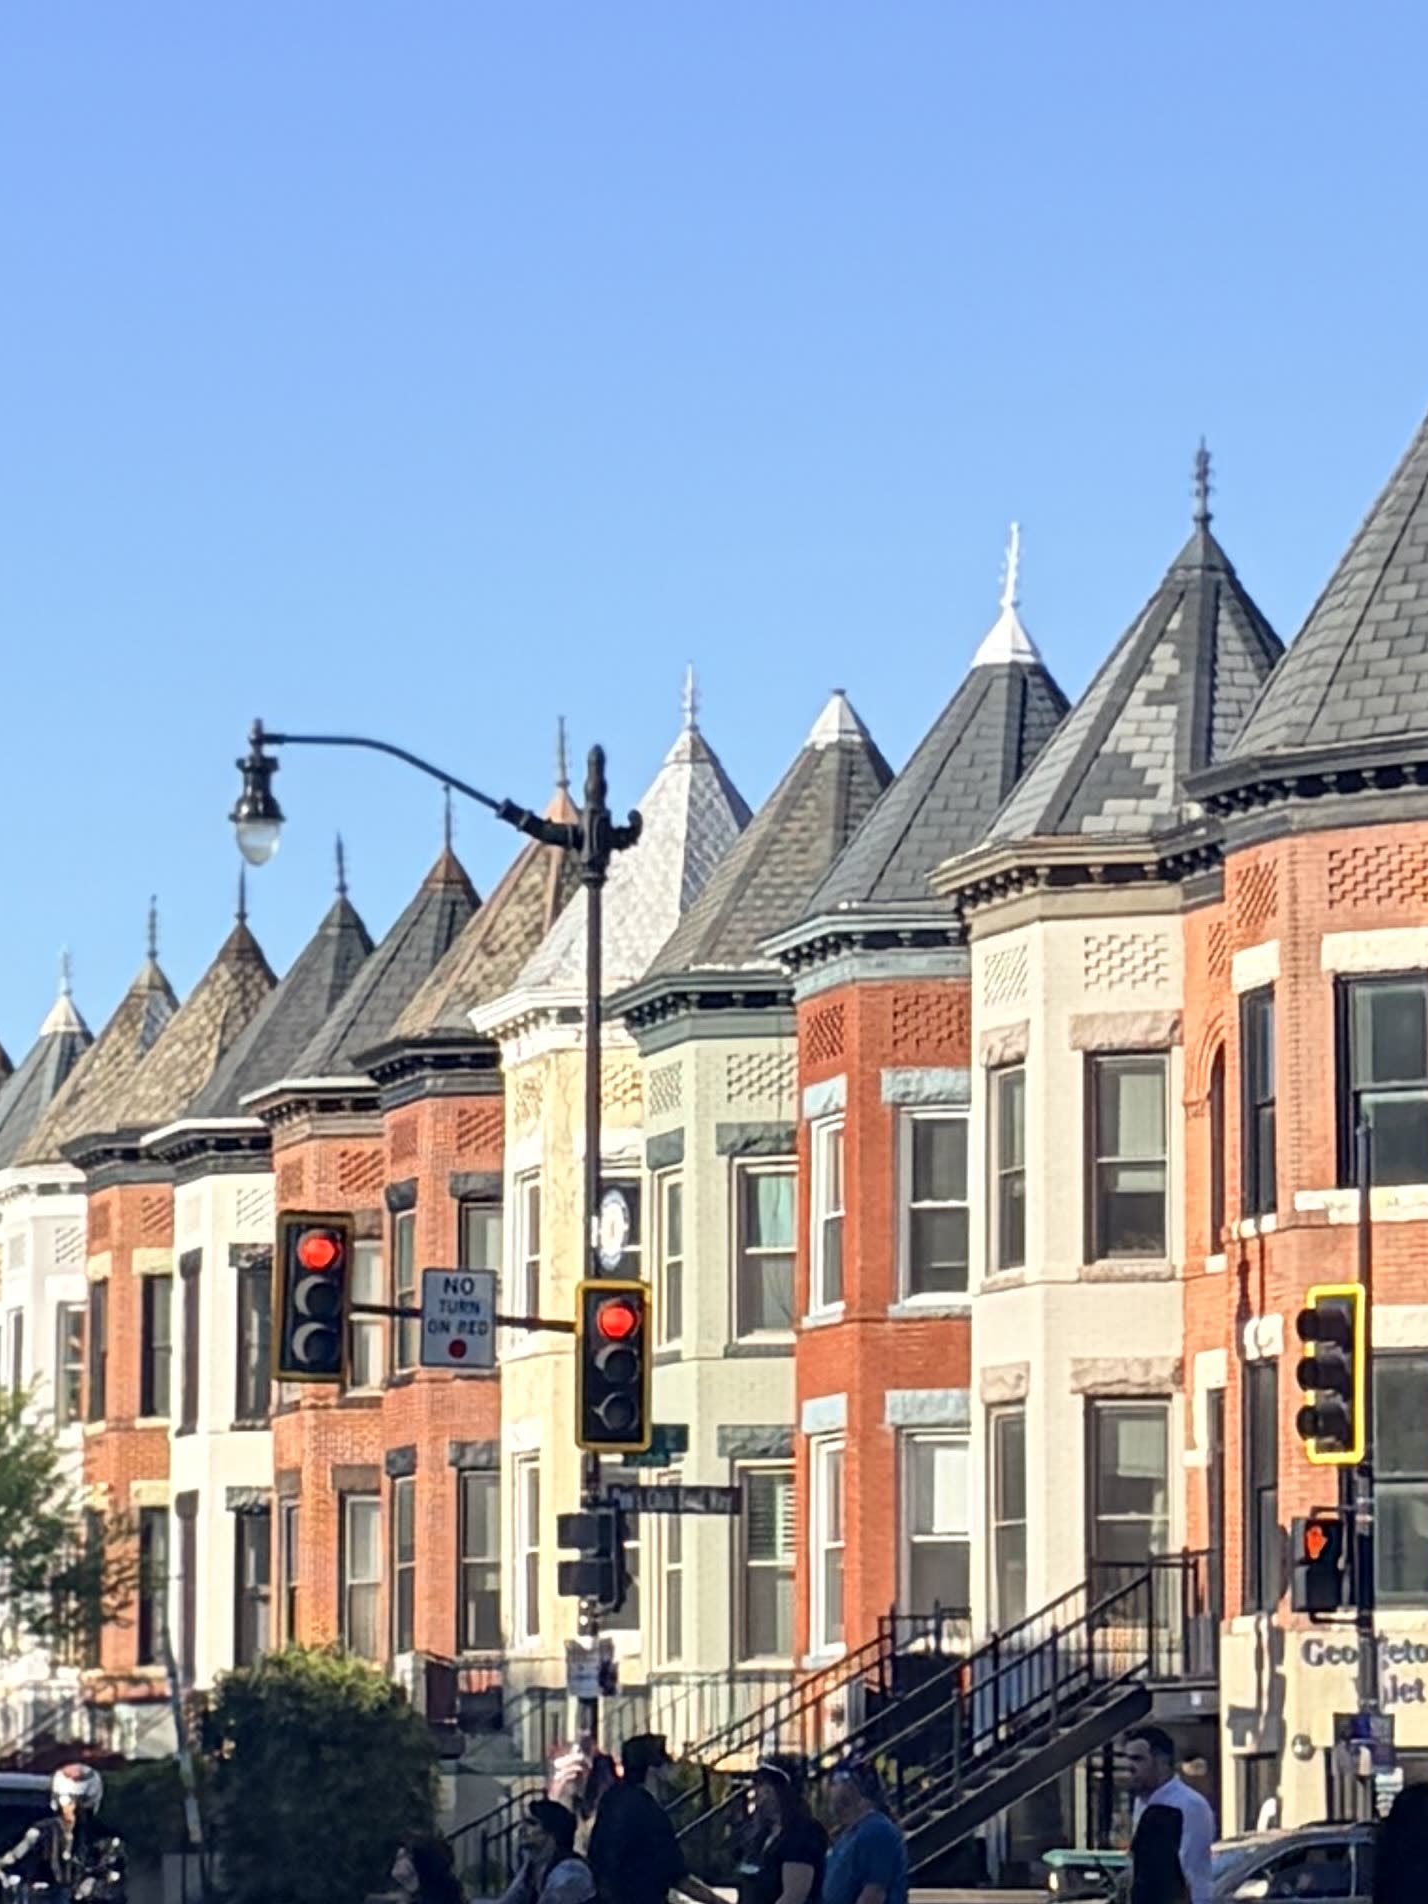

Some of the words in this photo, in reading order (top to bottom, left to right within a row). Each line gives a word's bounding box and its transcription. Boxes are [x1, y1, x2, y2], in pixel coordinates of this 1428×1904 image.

[443, 1277, 475, 1295] NO
[439, 1299, 480, 1314] TURN
[427, 1318, 451, 1335] ON
[458, 1319, 489, 1336] RED
